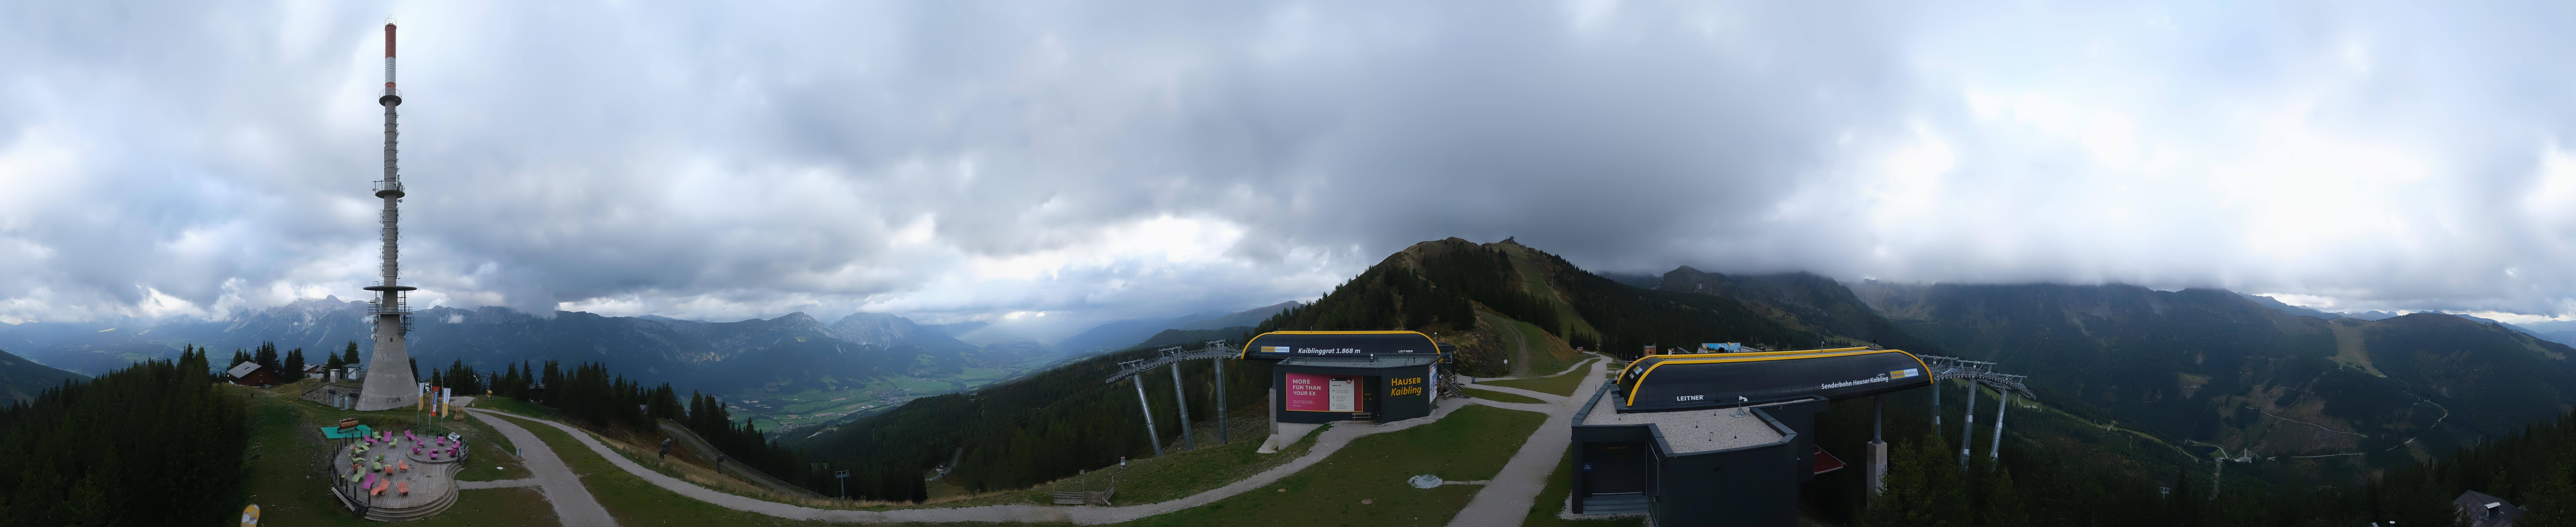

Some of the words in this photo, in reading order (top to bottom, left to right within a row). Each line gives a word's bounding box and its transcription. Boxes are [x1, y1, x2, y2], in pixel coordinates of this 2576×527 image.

[1391, 377, 1421, 386] HAUSER
[1821, 381, 1852, 389] Senderbahn
[1391, 386, 1422, 396] Kaibling
